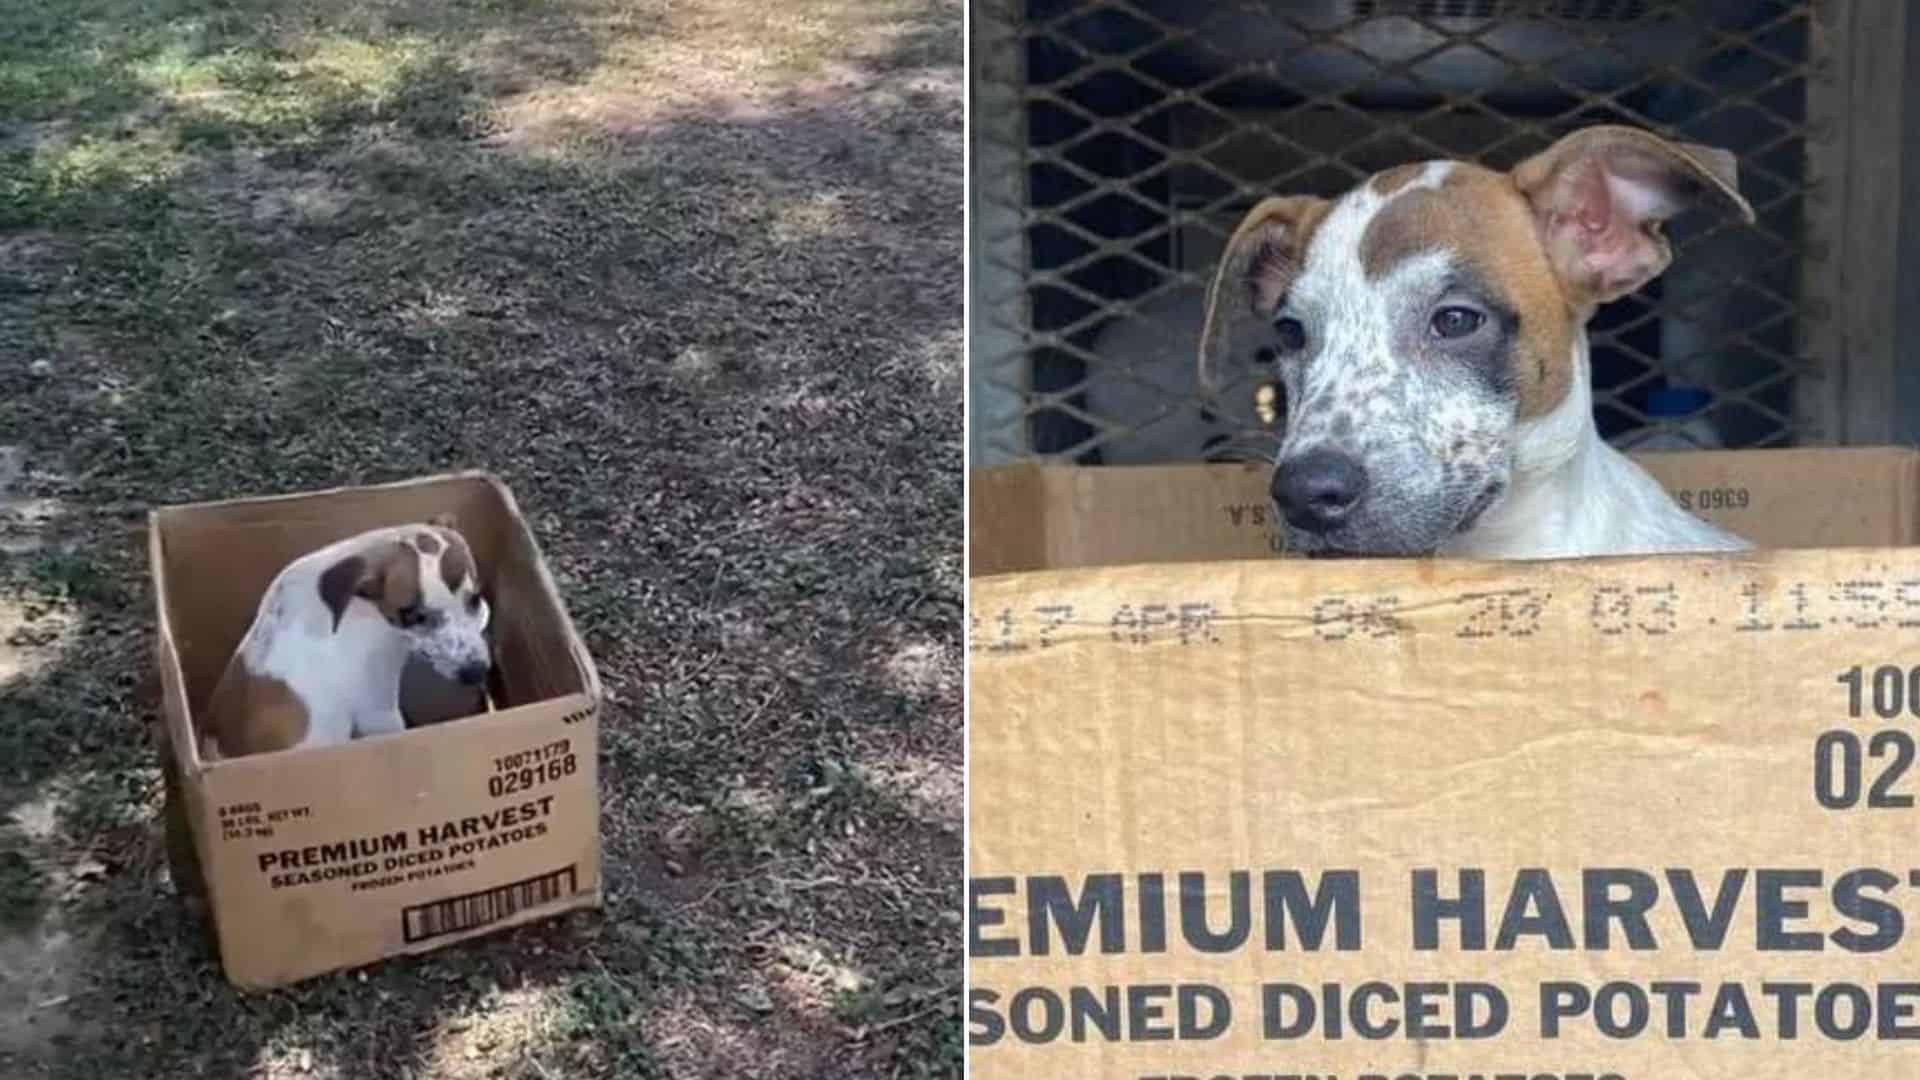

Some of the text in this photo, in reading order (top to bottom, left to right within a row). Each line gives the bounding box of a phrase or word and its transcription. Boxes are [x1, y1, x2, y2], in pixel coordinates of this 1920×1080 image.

[1111, 603, 1219, 645] APR
[488, 753, 576, 797] 029168
[1814, 729, 1916, 810] 02
[258, 796, 554, 873] PREMIUM HARVEST
[271, 822, 548, 890] SEASONED DICED POTATOES
[969, 867, 1920, 958] EMIUM HARVES
[969, 981, 1920, 1046] SONED DICED POTATOE
